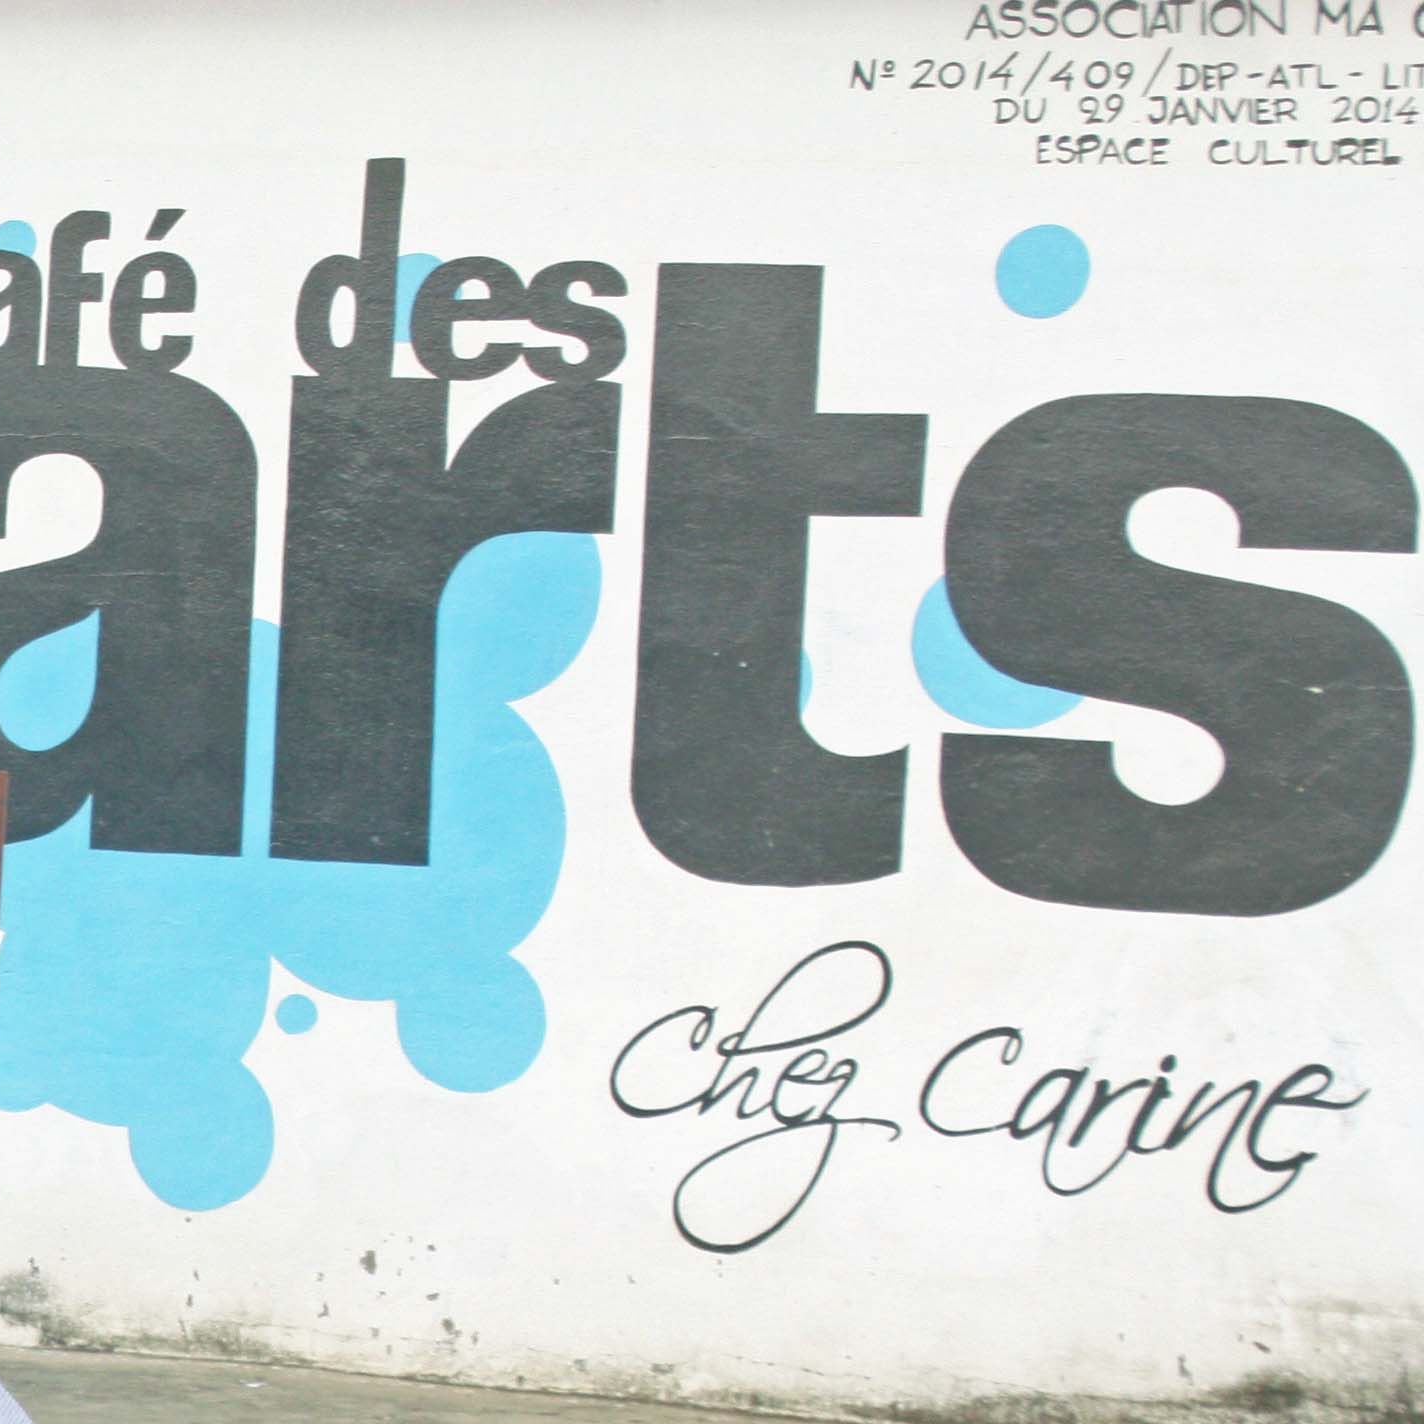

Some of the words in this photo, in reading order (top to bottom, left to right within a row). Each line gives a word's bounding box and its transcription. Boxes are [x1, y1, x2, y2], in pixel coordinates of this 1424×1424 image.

[965, 0, 1286, 40] ASSOCIATION
[1315, 0, 1384, 37] MA
[992, 97, 1046, 124] DU
[1078, 95, 1123, 124] 29
[1148, 96, 1297, 125] JANVIER
[1331, 96, 1419, 125] 2014
[1036, 134, 1170, 165] ESPACE
[1208, 137, 1401, 166] CULTUREL
[295, 157, 629, 382] des
[609, 940, 902, 1254] Chez
[919, 1026, 1370, 1214] Carine
